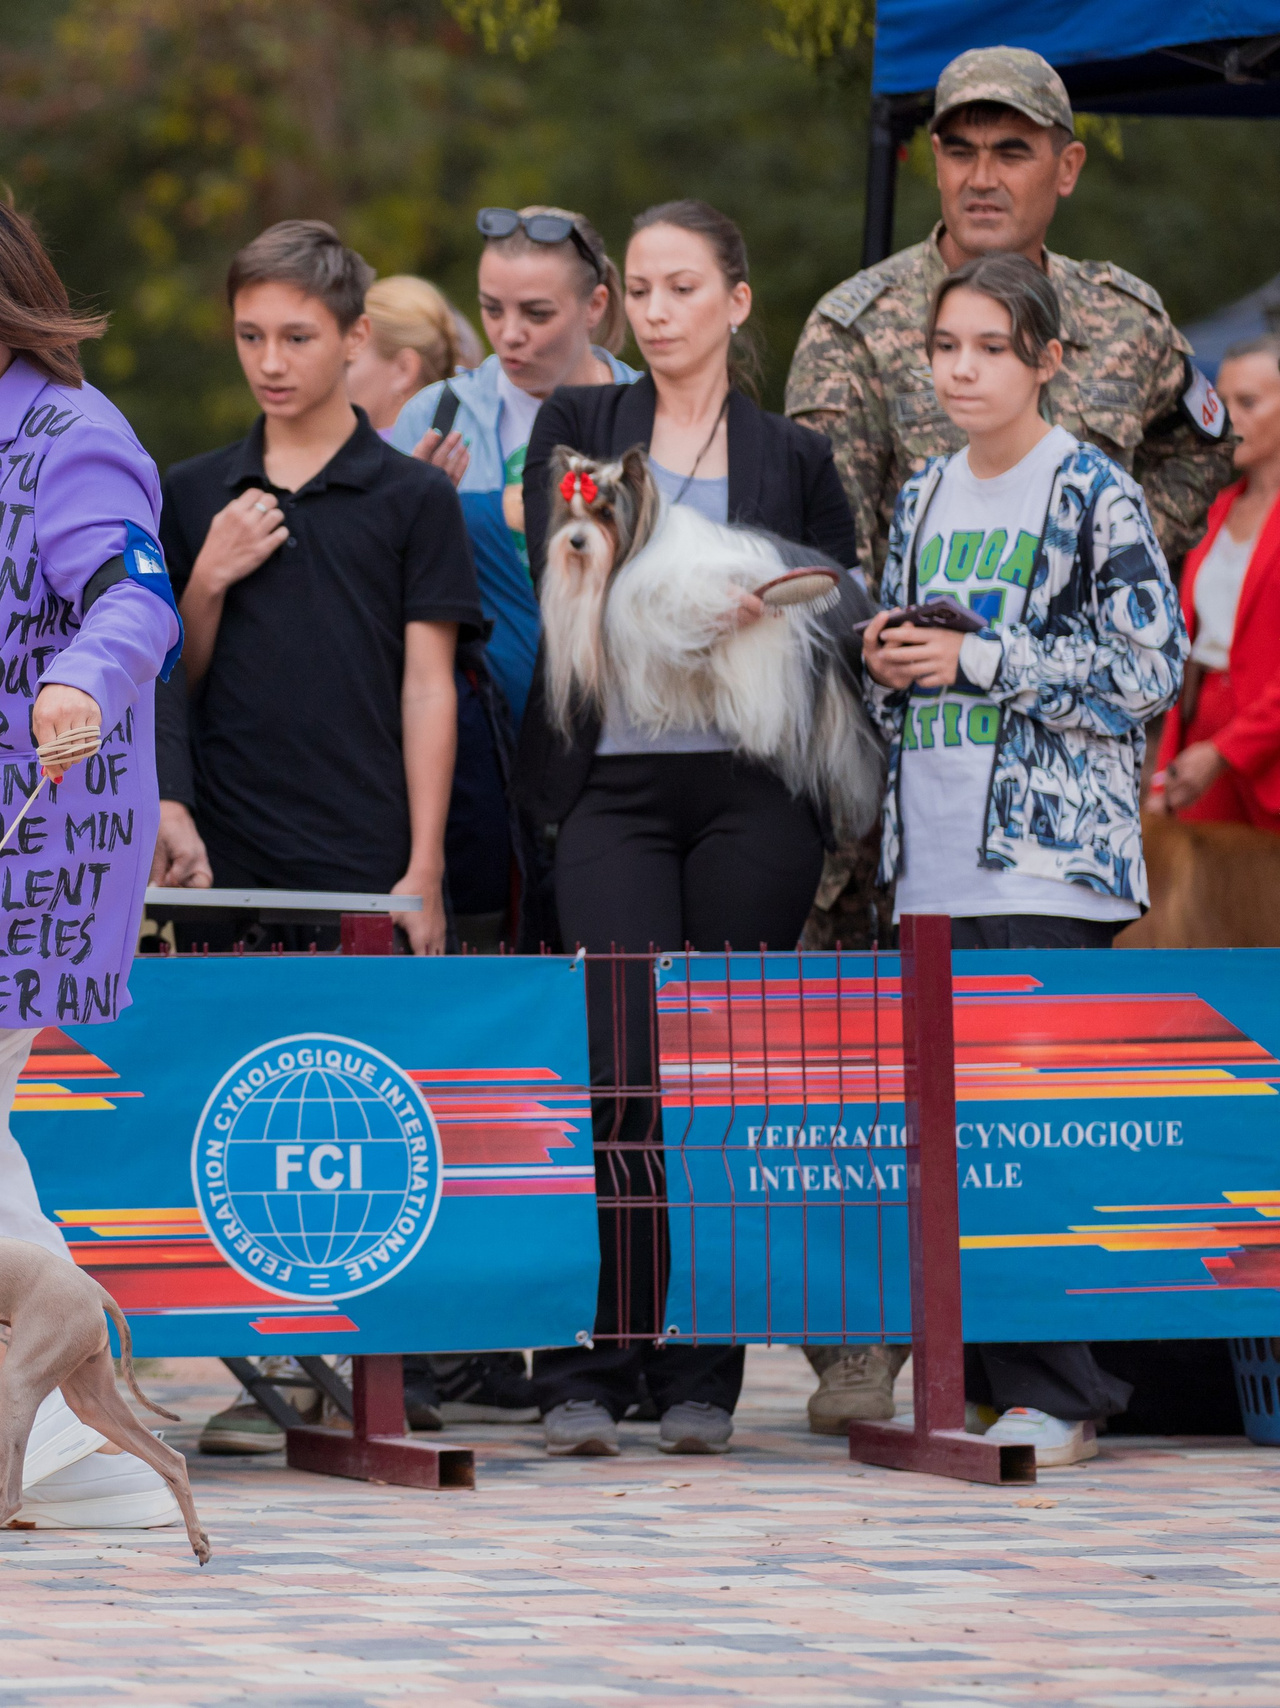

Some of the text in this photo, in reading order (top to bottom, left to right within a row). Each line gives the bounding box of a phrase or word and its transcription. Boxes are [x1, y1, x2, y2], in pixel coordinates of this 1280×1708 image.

[85, 753, 128, 796] OF
[65, 808, 134, 854] MIN
[955, 1120, 1184, 1152] CYNOLOGIQUE
[205, 1048, 430, 1282] FEDERATION CYNOLOGIQUE INTERNATIONALE
[275, 1144, 363, 1190] FCI
